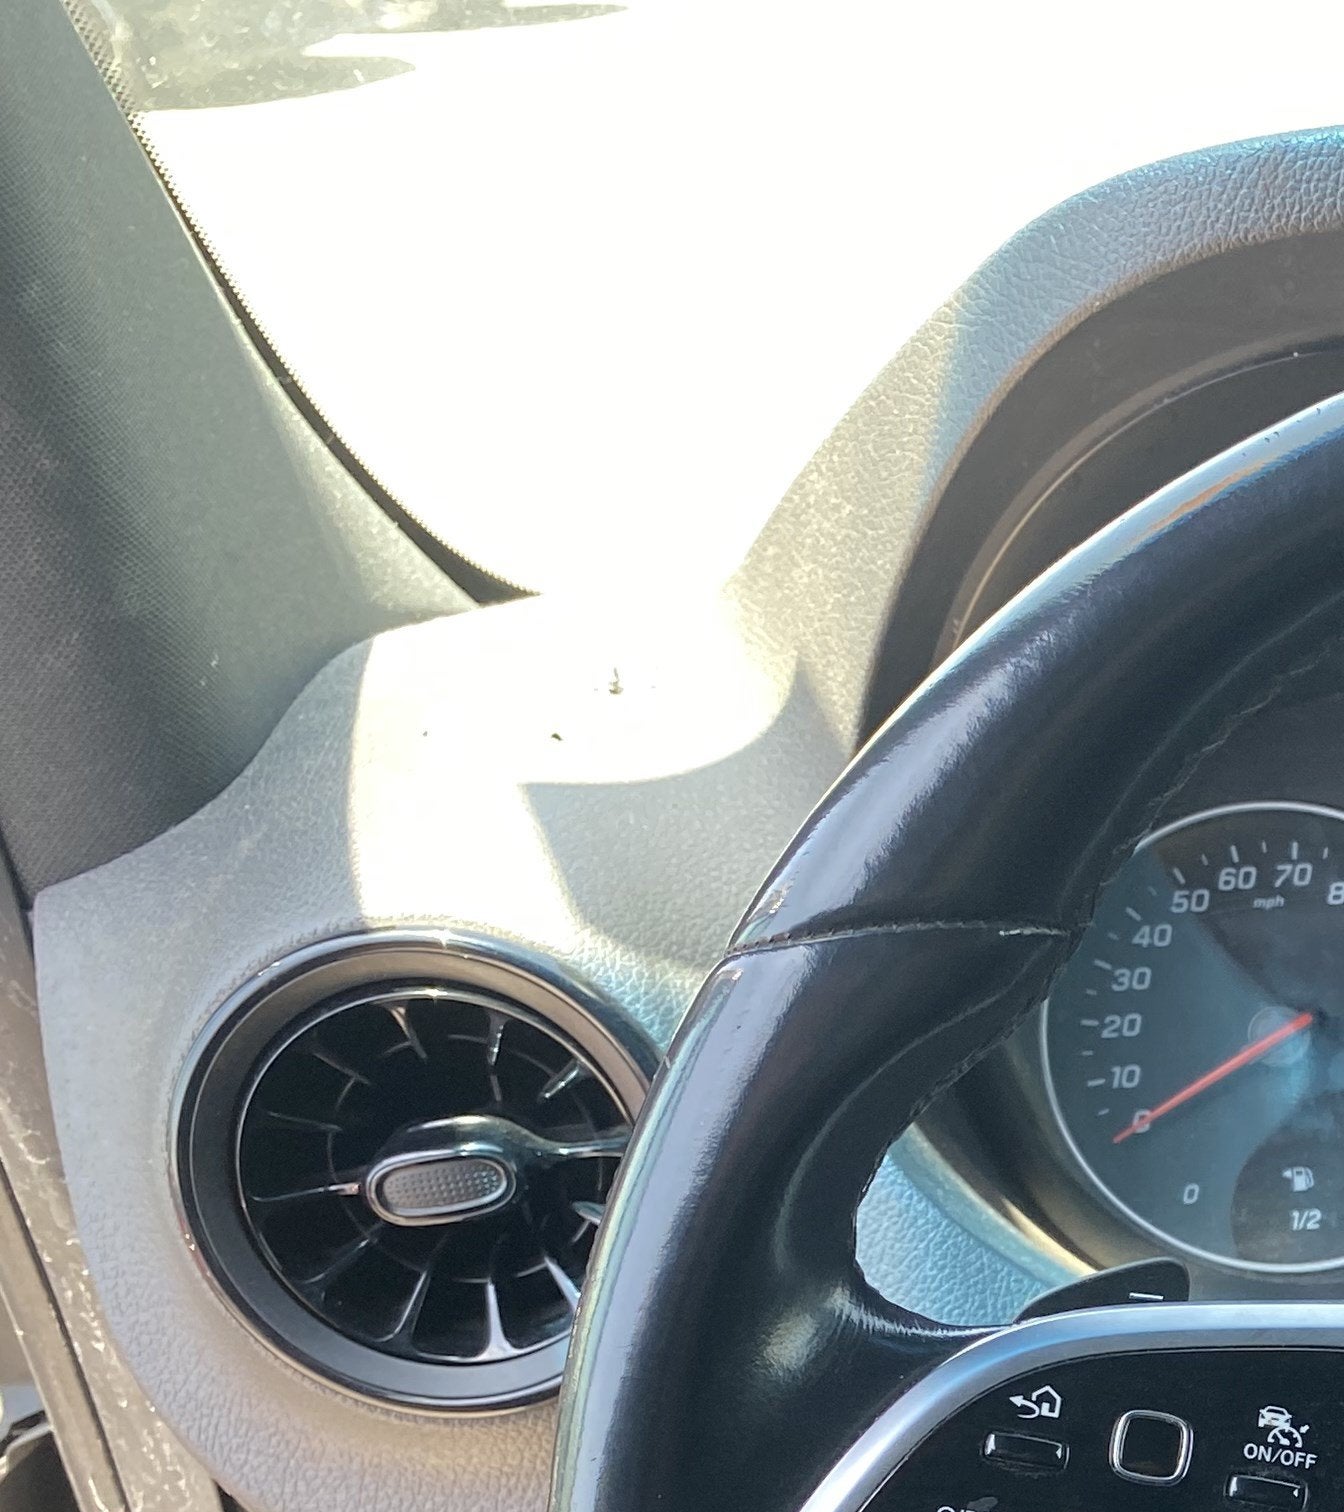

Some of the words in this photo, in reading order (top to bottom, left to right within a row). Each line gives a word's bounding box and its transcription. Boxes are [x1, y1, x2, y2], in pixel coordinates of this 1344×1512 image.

[1217, 867, 1257, 890] 60
[1275, 864, 1312, 888] 70
[1170, 889, 1210, 913] 50
[1253, 894, 1285, 911] mph
[1132, 925, 1172, 948] 40
[1111, 968, 1152, 992] 30
[1101, 1015, 1142, 1038] 20
[1110, 1065, 1142, 1089] 10
[1182, 1184, 1200, 1205] 0
[1291, 1210, 1322, 1231] 1/2
[1242, 1441, 1318, 1471] ON/OFF
